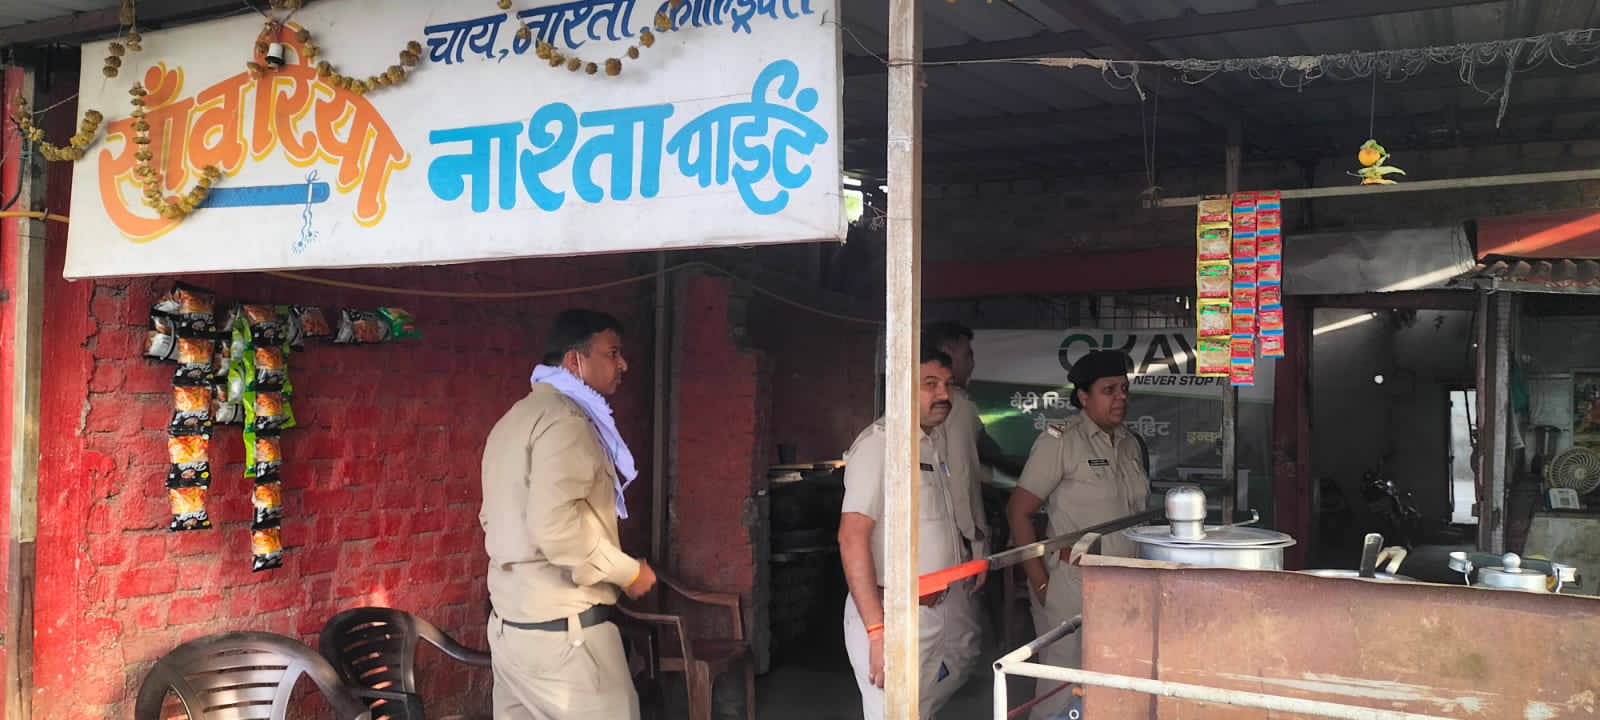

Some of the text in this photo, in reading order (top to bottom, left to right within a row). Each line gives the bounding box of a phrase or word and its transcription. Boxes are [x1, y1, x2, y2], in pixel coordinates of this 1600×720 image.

[98, 20, 411, 243] साँवरिया
[427, 102, 674, 213] नाश्ता
[1133, 375, 1177, 385] NEVER
[1178, 376, 1214, 386] STOP
